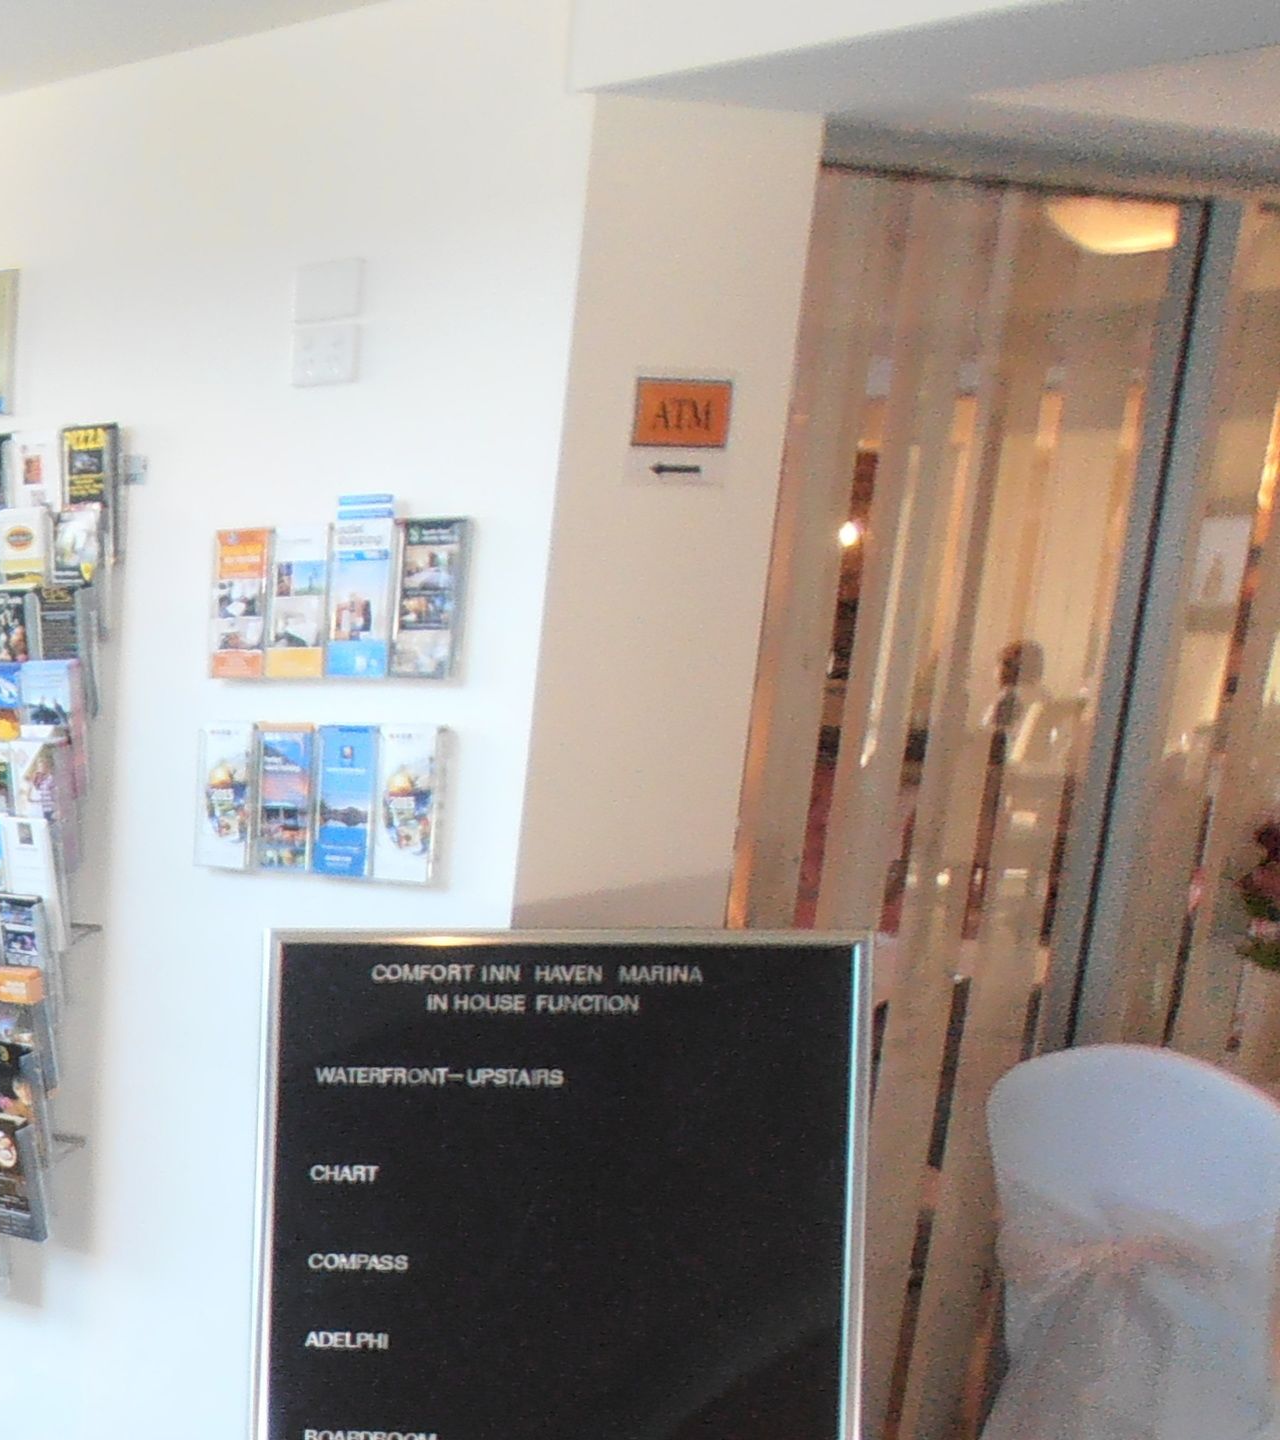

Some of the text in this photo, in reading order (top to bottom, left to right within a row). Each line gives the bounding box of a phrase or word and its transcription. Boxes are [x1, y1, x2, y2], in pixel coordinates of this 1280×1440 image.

[651, 398, 712, 433] ATM
[371, 963, 703, 983] COMFORT INN HAVEN MARINA
[426, 994, 640, 1013] IN HOUSE FUNCTION
[309, 1163, 379, 1183] CHART
[307, 1252, 409, 1273] COMPASS
[304, 1331, 389, 1351] ADELPHI
